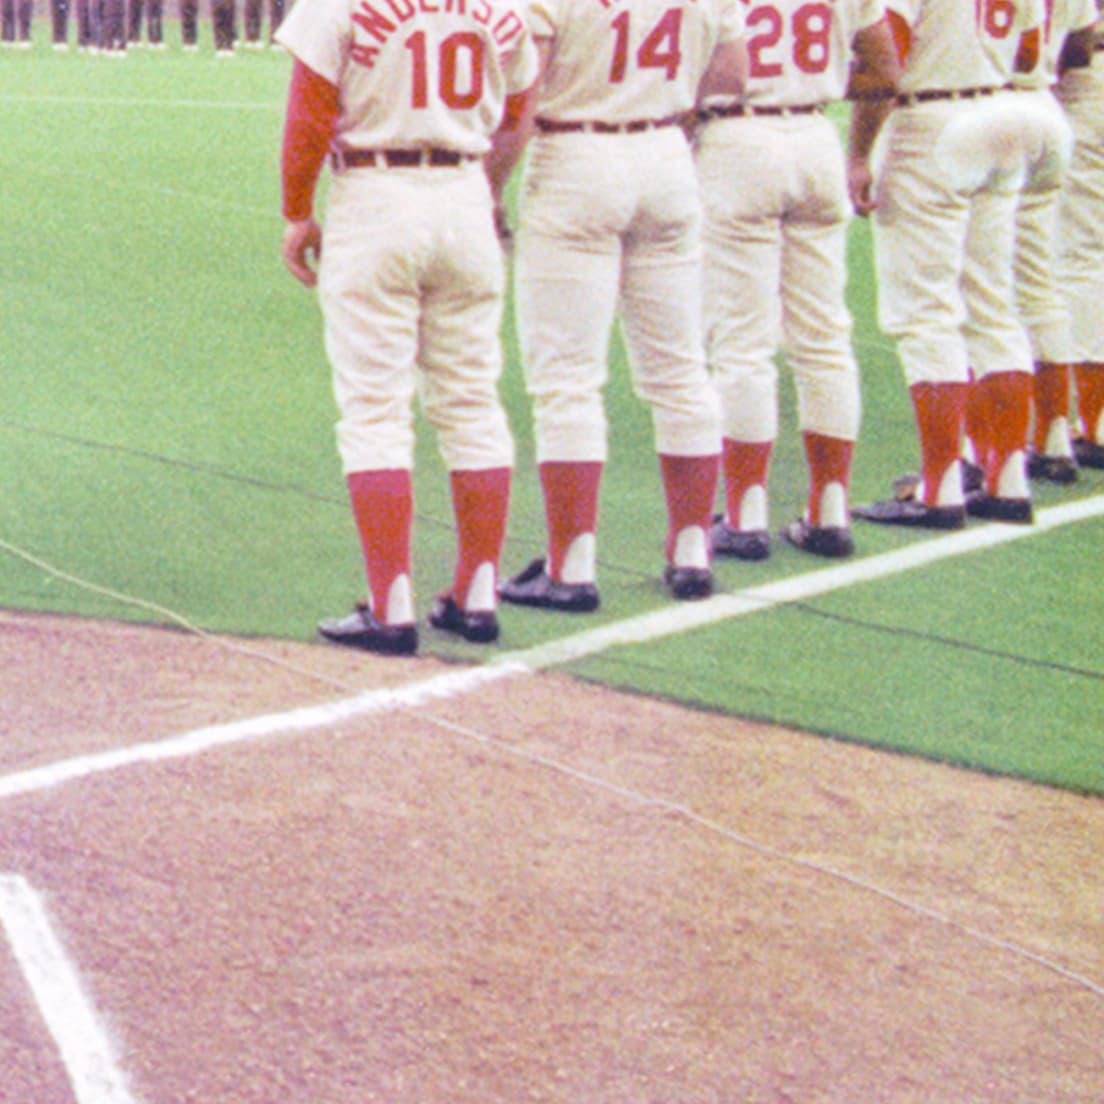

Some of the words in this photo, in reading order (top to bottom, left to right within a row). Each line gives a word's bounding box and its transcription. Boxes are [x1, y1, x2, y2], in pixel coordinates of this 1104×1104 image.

[404, 29, 486, 111] 10
[609, 7, 684, 84] 14
[746, 1, 833, 79] 28
